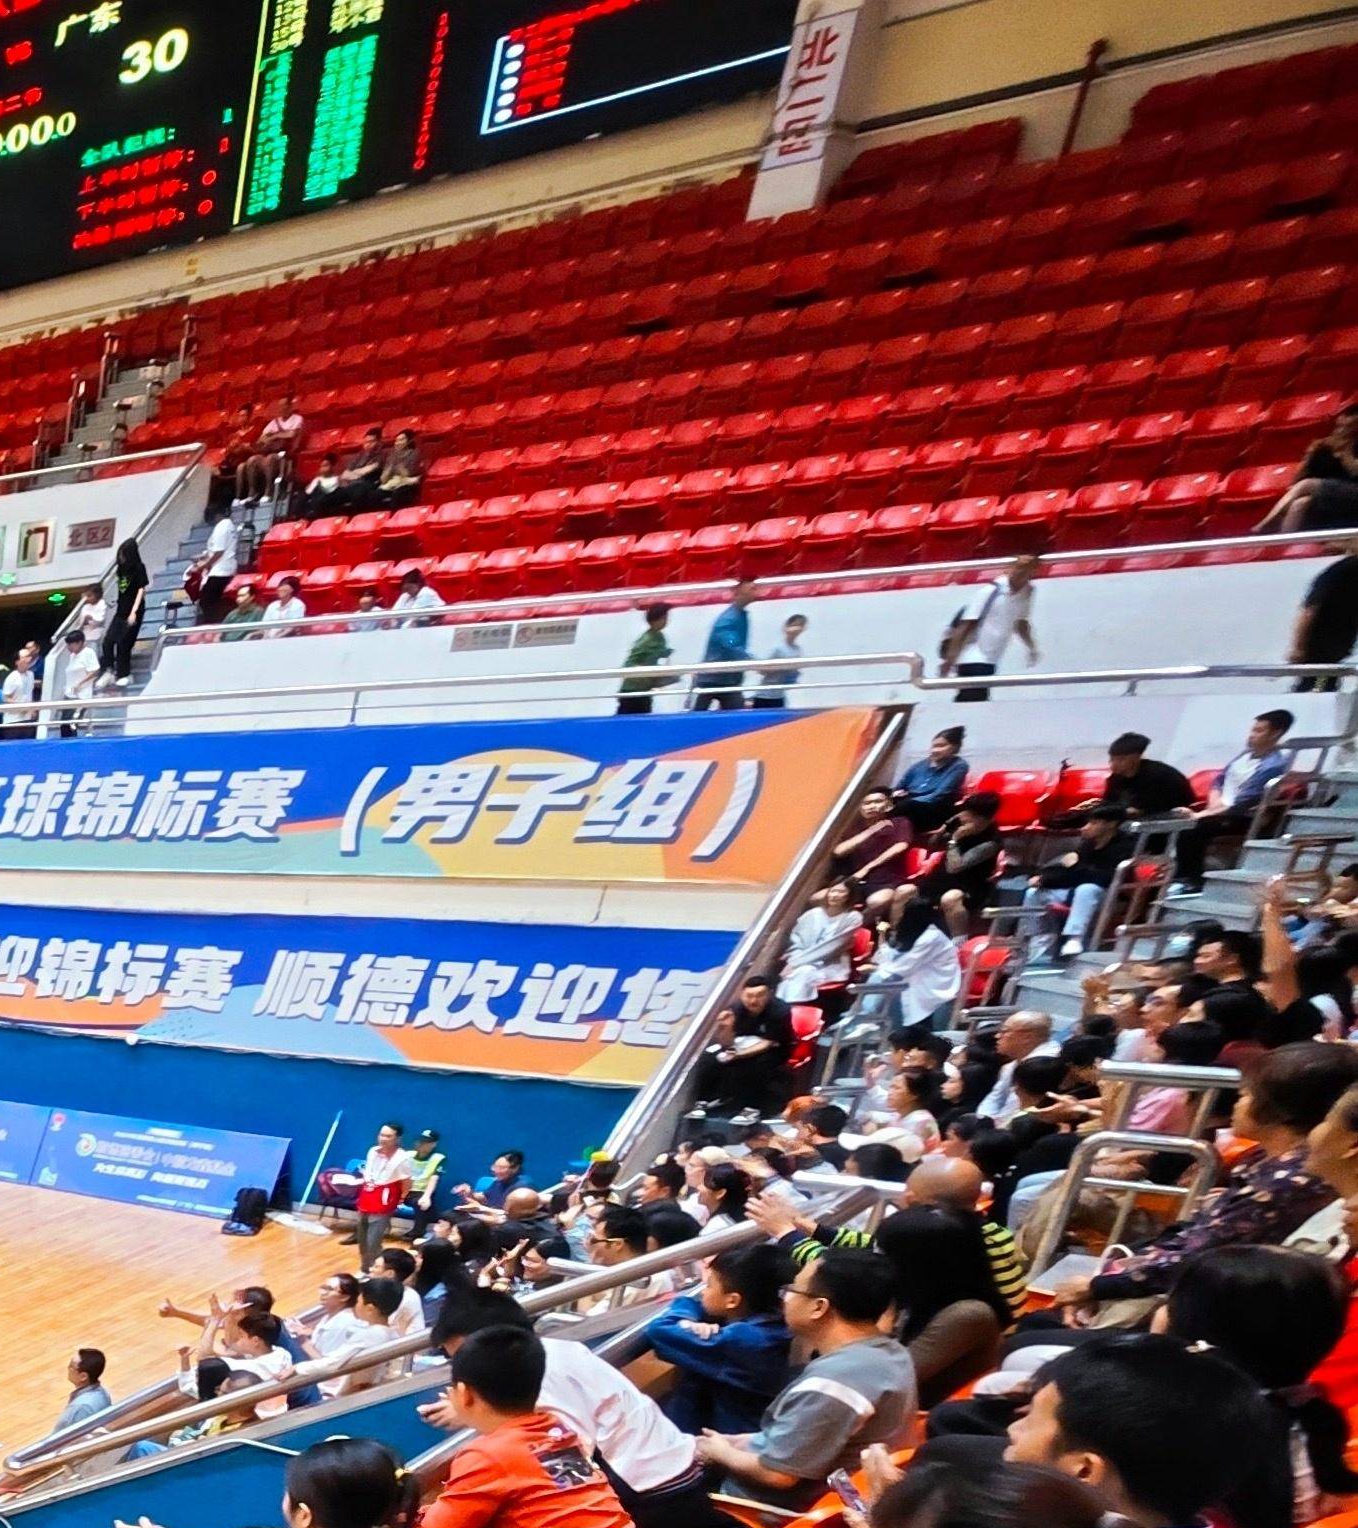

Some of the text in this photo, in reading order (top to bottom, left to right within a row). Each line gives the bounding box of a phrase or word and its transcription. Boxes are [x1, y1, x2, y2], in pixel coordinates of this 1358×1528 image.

[54, 1, 123, 47] 广东
[119, 28, 189, 84] 30
[68, 526, 111, 547] 北区2
[253, 948, 717, 1048] 顺德欢迎您
